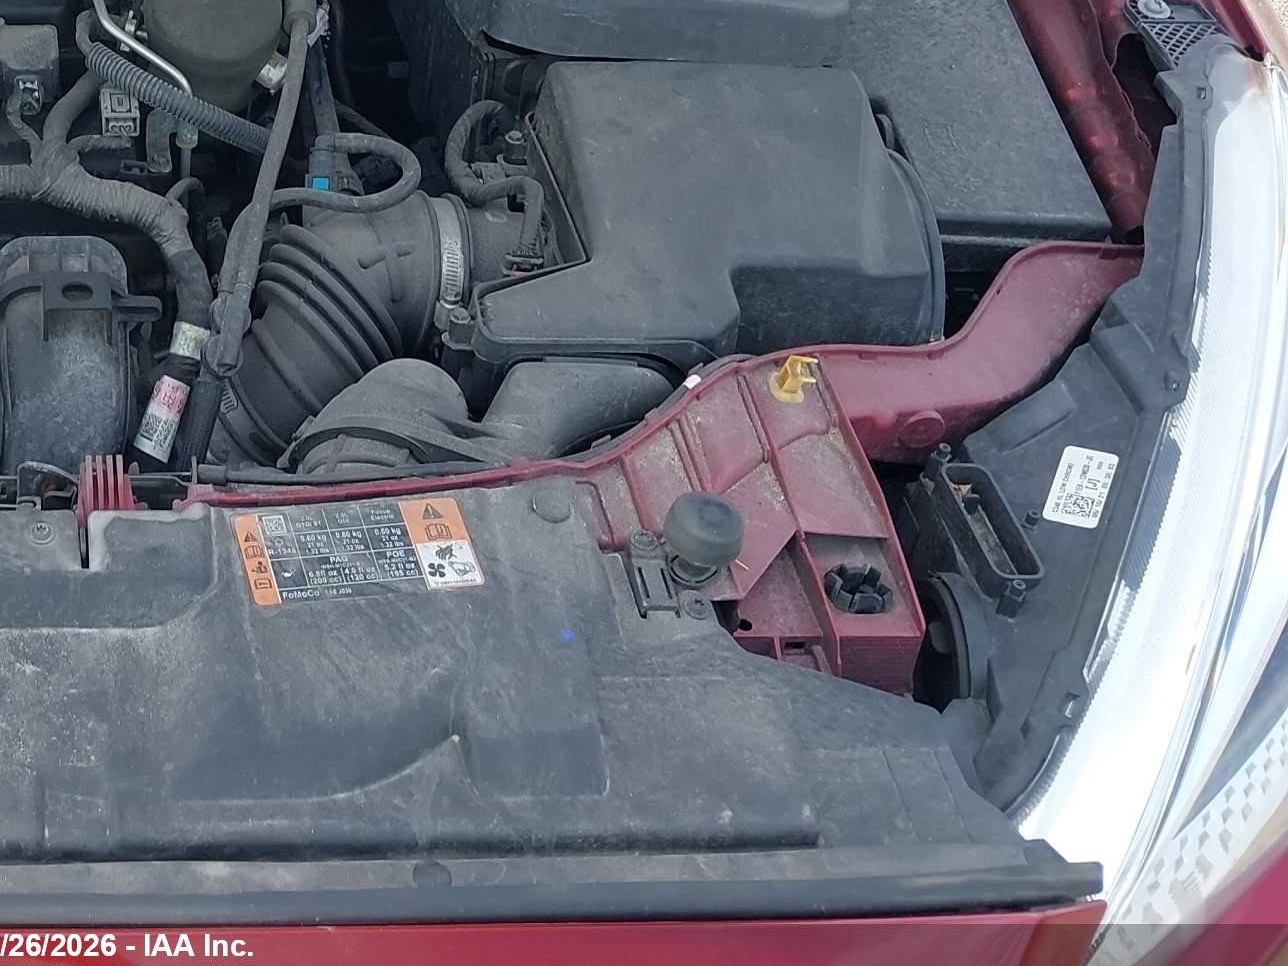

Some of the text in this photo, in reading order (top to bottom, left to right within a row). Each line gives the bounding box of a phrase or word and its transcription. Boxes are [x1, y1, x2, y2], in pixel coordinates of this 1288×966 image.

[391, 527, 401, 535] kg
[317, 534, 327, 542] kg
[268, 548, 296, 556] R-134a
[386, 550, 405, 558] POE
[330, 556, 348, 564] PAG
[388, 569, 418, 578] (155 cc)
[310, 575, 342, 585] (200 cc)
[347, 574, 364, 582] (120
[282, 590, 320, 600] FoMoCo
